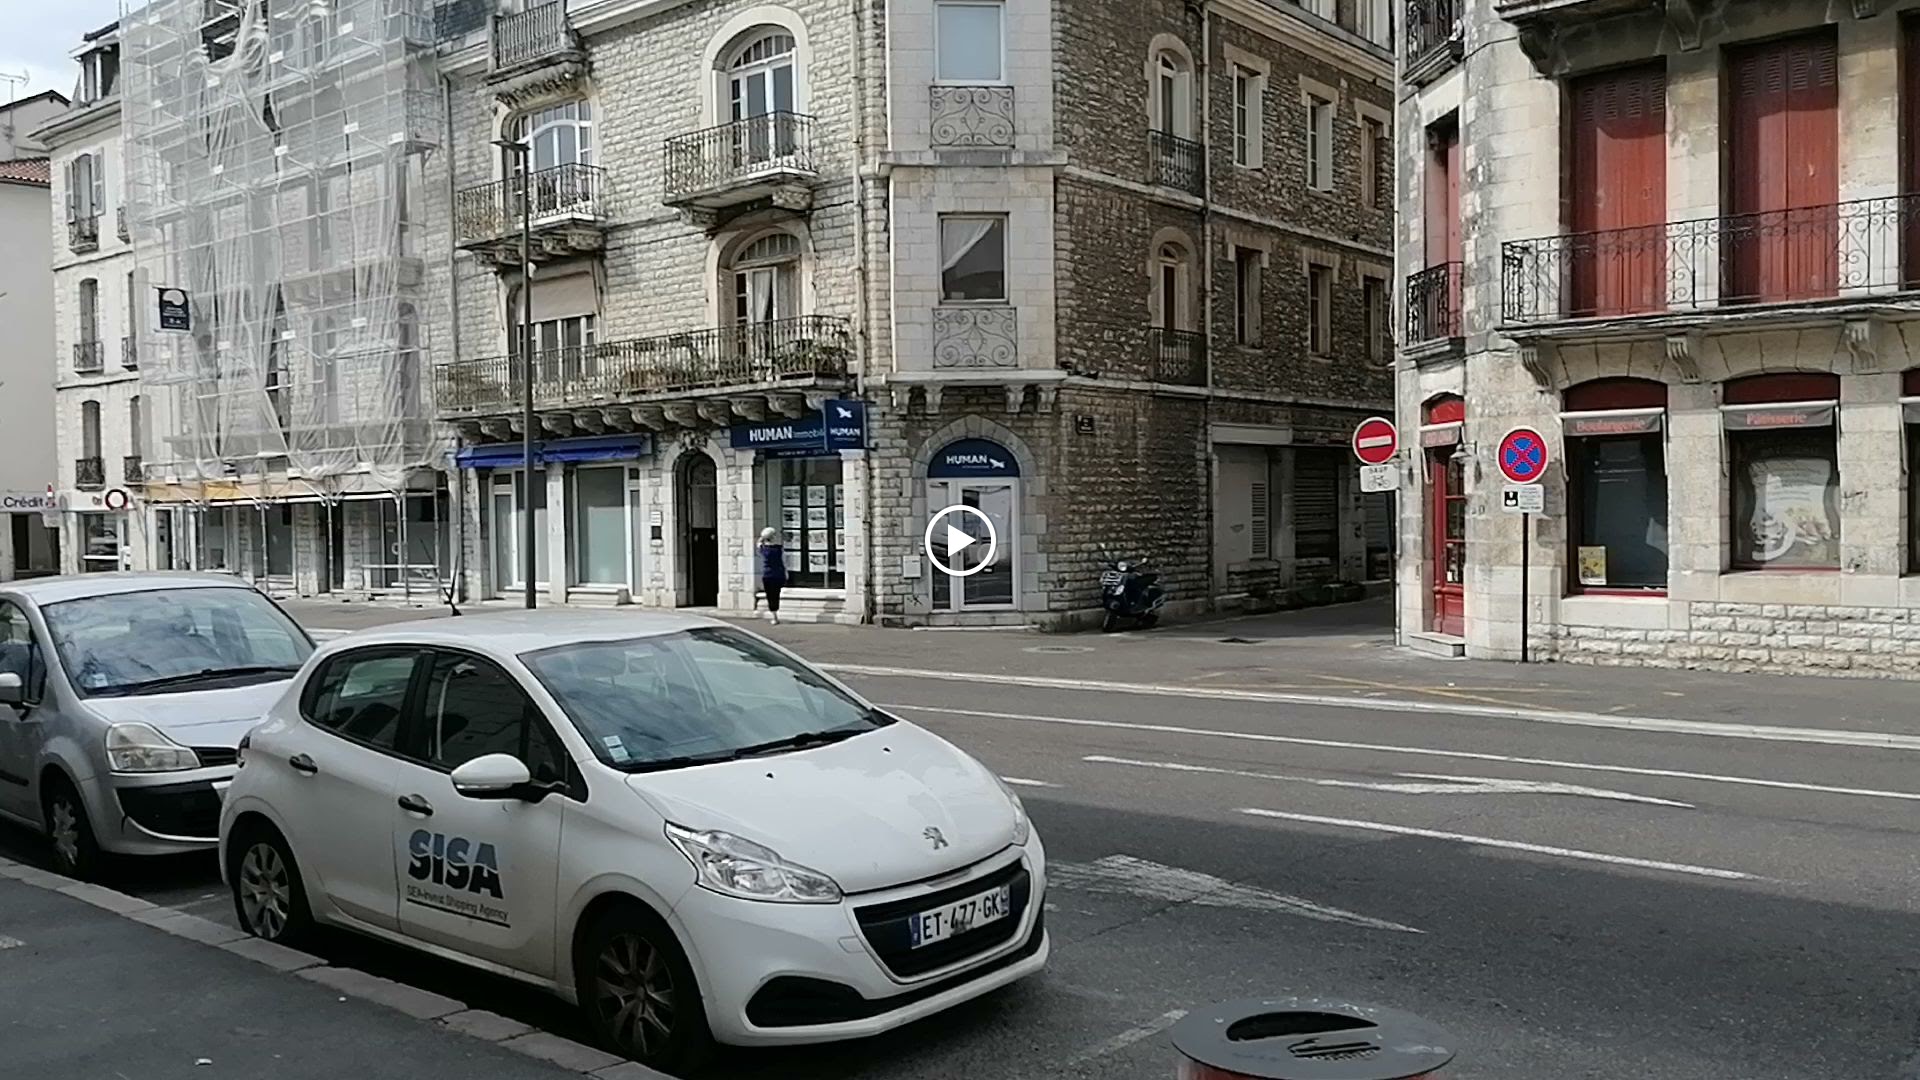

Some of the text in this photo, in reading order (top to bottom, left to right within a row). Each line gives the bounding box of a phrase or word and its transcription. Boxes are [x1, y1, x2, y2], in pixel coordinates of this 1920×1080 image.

[830, 428, 861, 437] HUMAN
[1576, 418, 1645, 433] Boulangerie
[749, 426, 793, 442] HUMAN
[946, 454, 988, 465] HUMAN
[4, 496, 44, 508] Crédit
[408, 829, 504, 899] SISA
[479, 903, 509, 922] Agency
